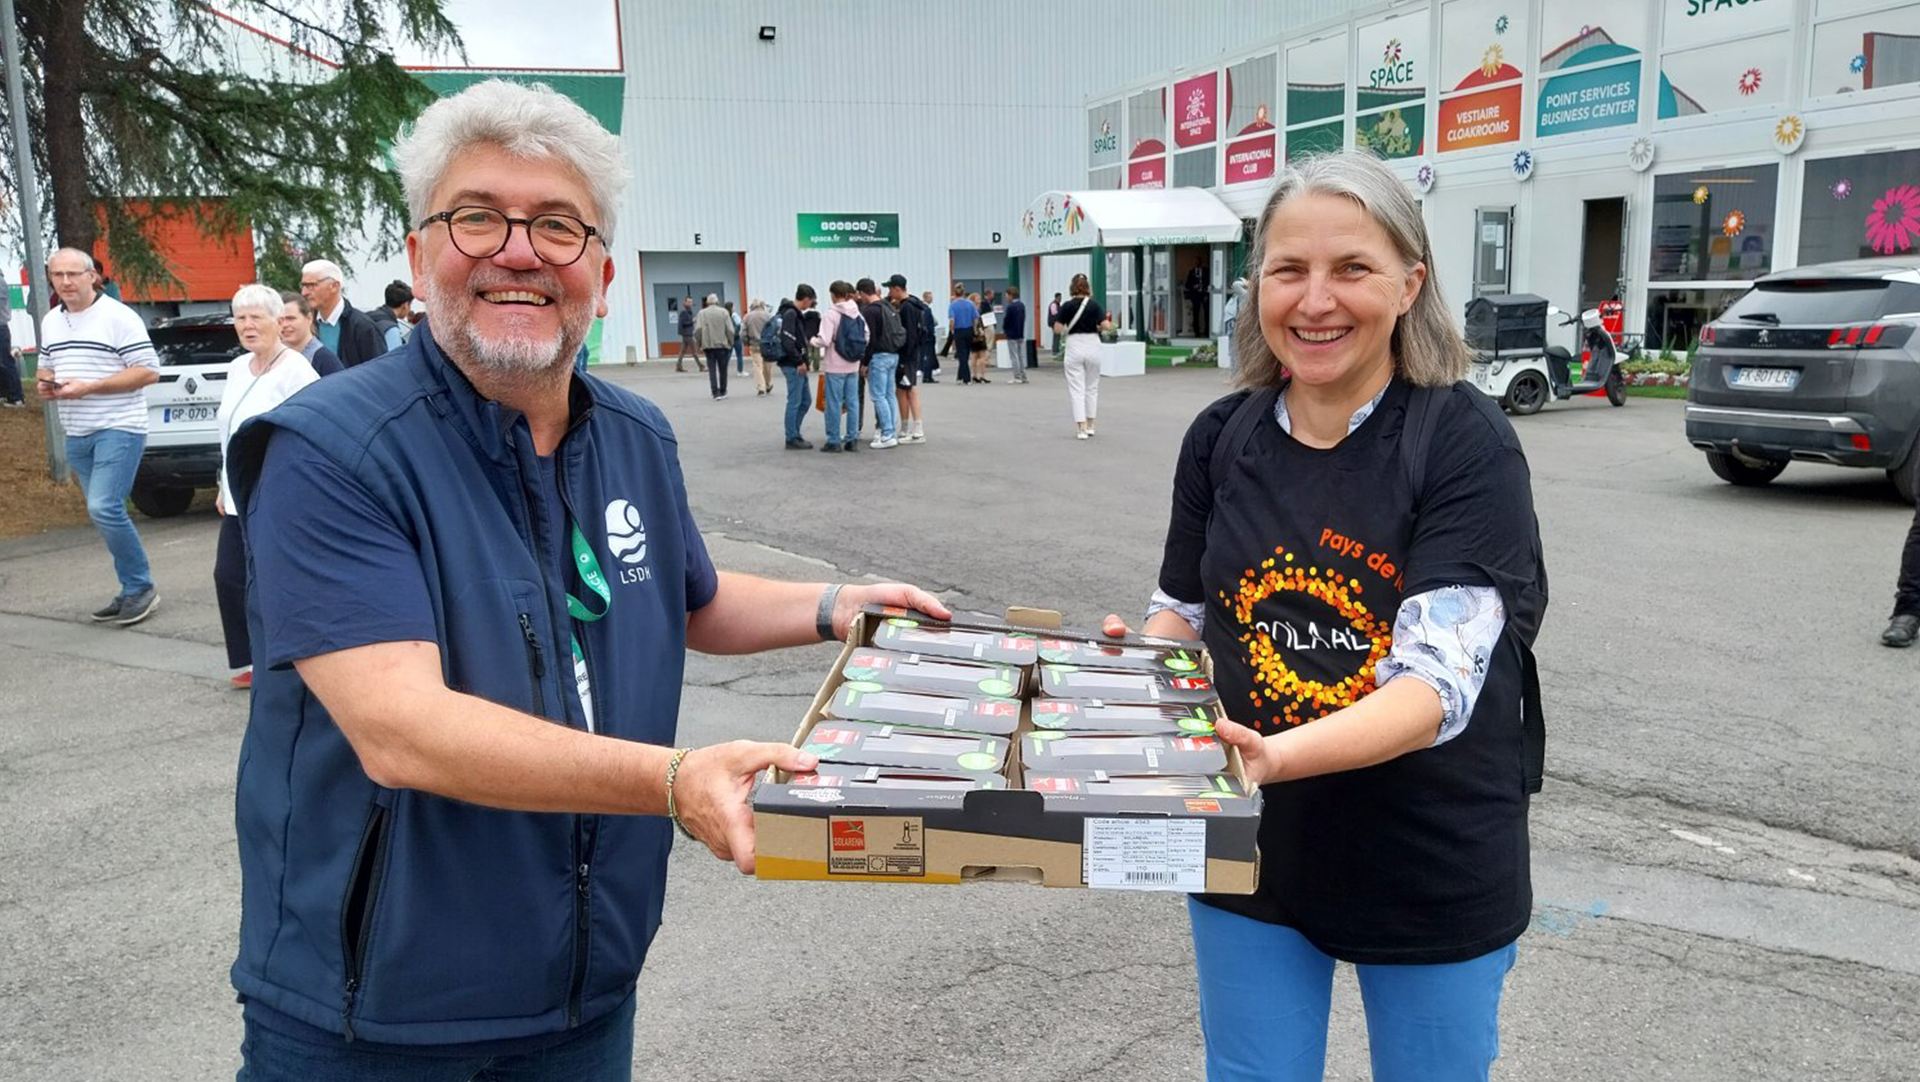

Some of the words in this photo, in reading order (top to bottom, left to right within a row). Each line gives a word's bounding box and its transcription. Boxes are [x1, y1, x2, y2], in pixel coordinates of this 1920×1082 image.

[1370, 61, 1413, 88] SPACE
[1546, 91, 1578, 109] POINT
[1580, 81, 1631, 103] SERVICES
[1456, 105, 1500, 124] VESTIAIRE
[1541, 106, 1590, 126] BUSINESS
[1592, 99, 1636, 118] CENTER
[1447, 120, 1510, 142] CLOAKROOMS
[1094, 135, 1116, 154] SPACE
[1229, 148, 1272, 165] INTERNATIONAL
[1243, 163, 1258, 174] CLUB
[1037, 218, 1063, 238] SPACE
[694, 233, 701, 245] E
[810, 234, 841, 243] space.fr
[992, 232, 1002, 243] D
[1157, 233, 1207, 244] International
[172, 407, 219, 420] GP-070-Y
[1319, 528, 1364, 558] Pays
[1367, 552, 1396, 579] de
[833, 837, 864, 847] SOLARENN
